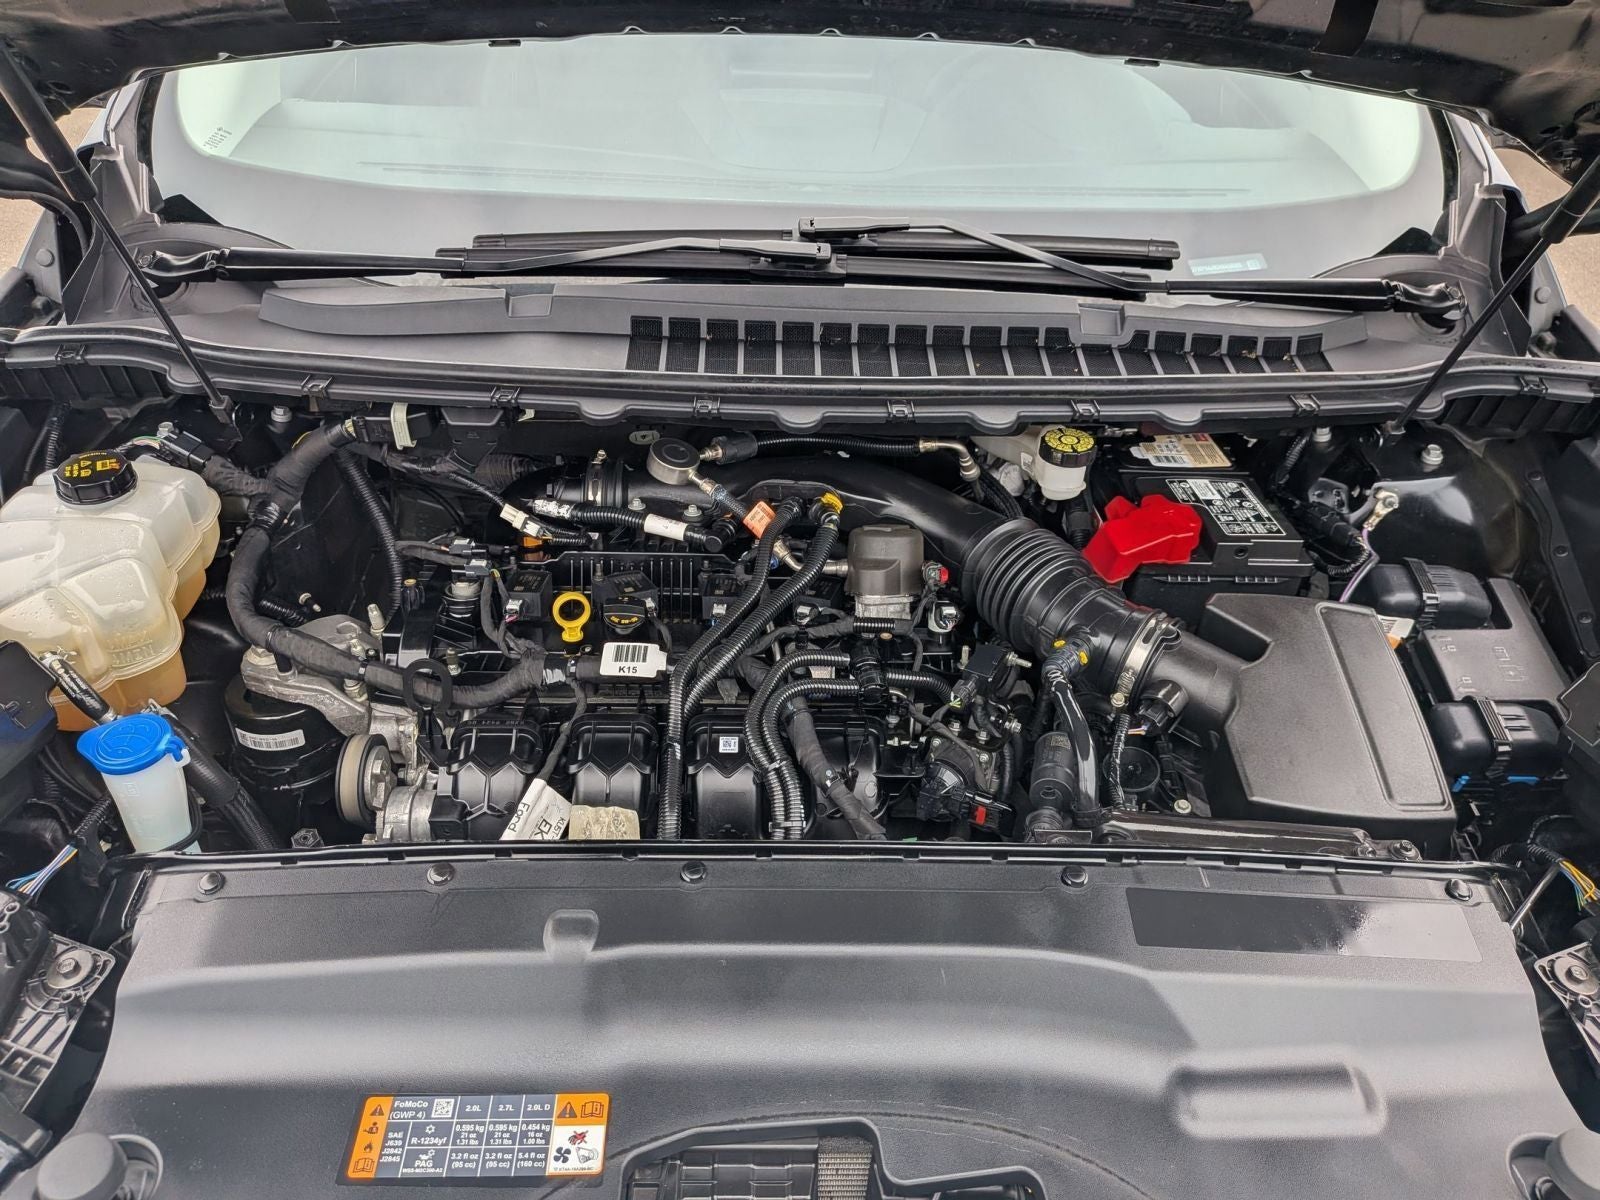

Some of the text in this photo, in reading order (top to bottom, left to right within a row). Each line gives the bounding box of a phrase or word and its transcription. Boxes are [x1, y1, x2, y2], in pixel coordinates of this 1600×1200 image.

[618, 665, 638, 674] K15
[508, 802, 530, 833] Ford
[394, 1100, 429, 1108] FoMoCo
[389, 1111, 426, 1119] (GWP 4)
[475, 1124, 485, 1132] kg
[508, 1124, 518, 1132] kg
[541, 1124, 551, 1132] kg
[388, 1131, 404, 1139] SAE
[411, 1137, 447, 1146] R-1234yf
[414, 1160, 433, 1168] PAG
[464, 1161, 476, 1169] cc)
